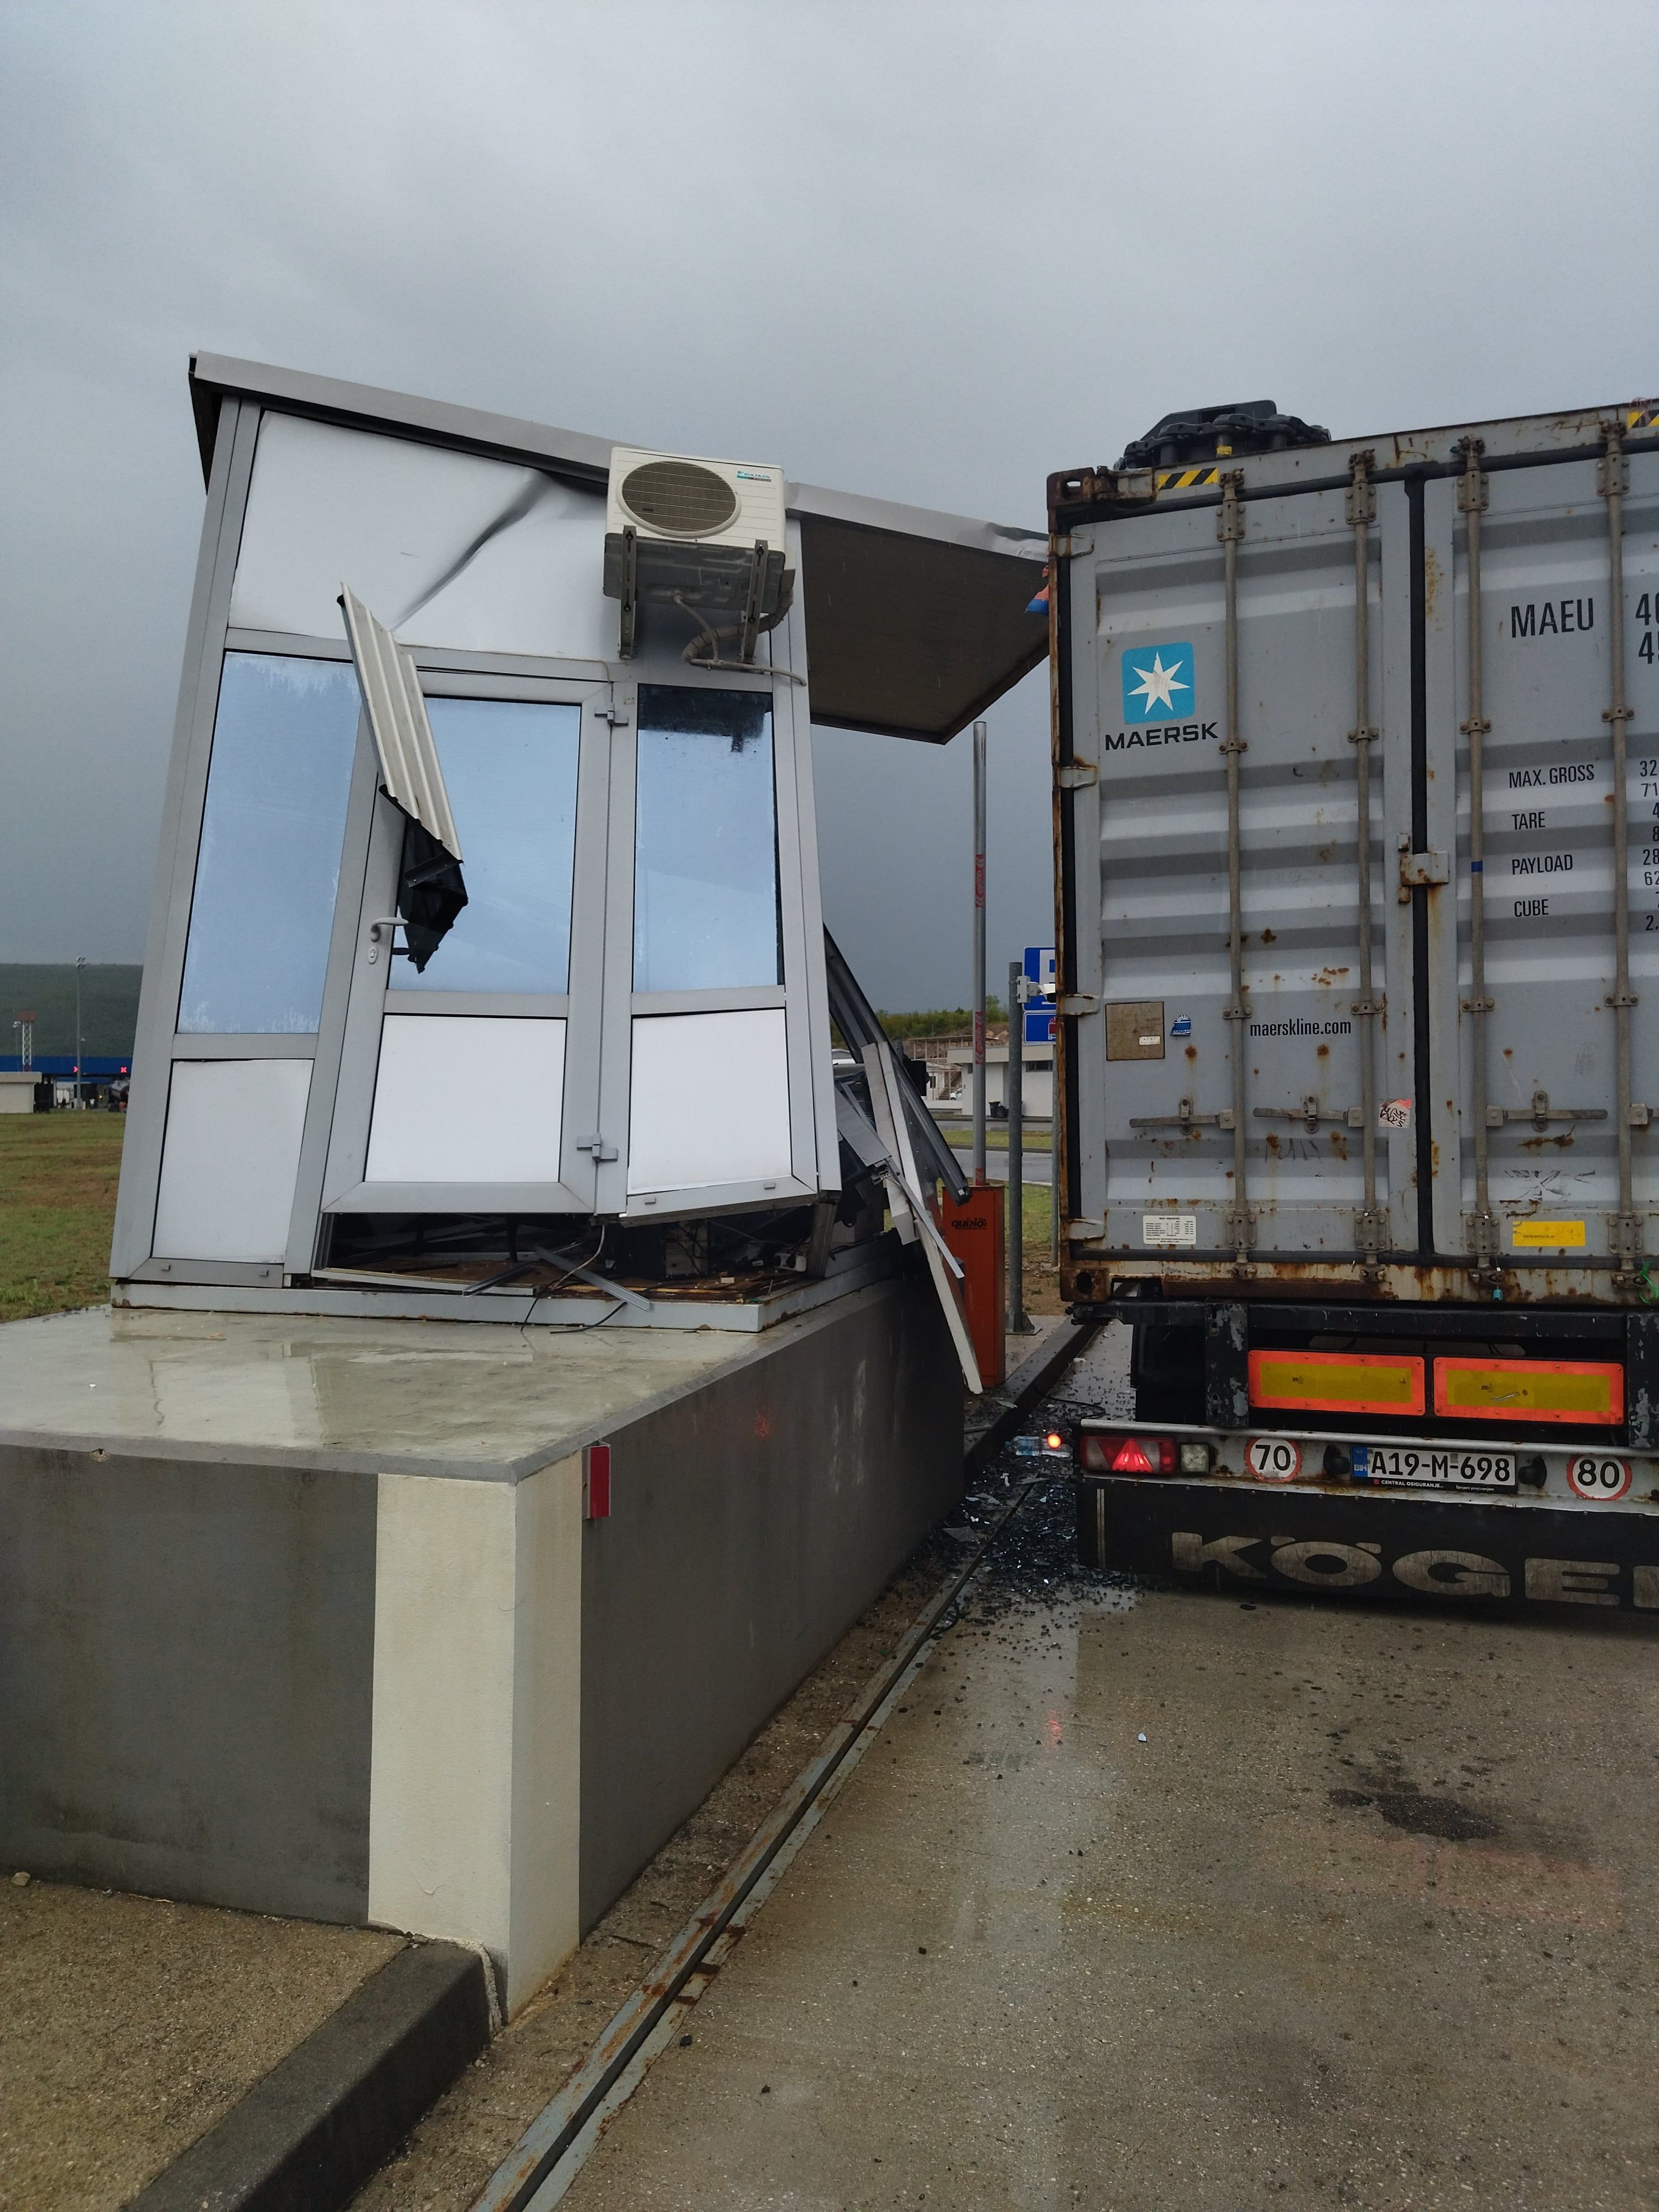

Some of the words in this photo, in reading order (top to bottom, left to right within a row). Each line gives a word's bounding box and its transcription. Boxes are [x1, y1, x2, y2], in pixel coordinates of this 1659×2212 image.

[1511, 598, 1594, 638] MAEU
[1635, 592, 1659, 625] 4
[1639, 632, 1659, 664] 4
[1105, 722, 1219, 751] MAERSK
[1509, 769, 1546, 789] MAX.
[1550, 764, 1595, 785] GROSS
[1511, 811, 1546, 830] TARE
[1511, 854, 1573, 875] PAYLOAD
[1514, 899, 1549, 917] CUBE
[1250, 1018, 1351, 1036] maerskline.com
[1255, 1444, 1291, 1471] 70
[1371, 1451, 1510, 1481] A19-M-698
[1578, 1459, 1620, 1488] 80
